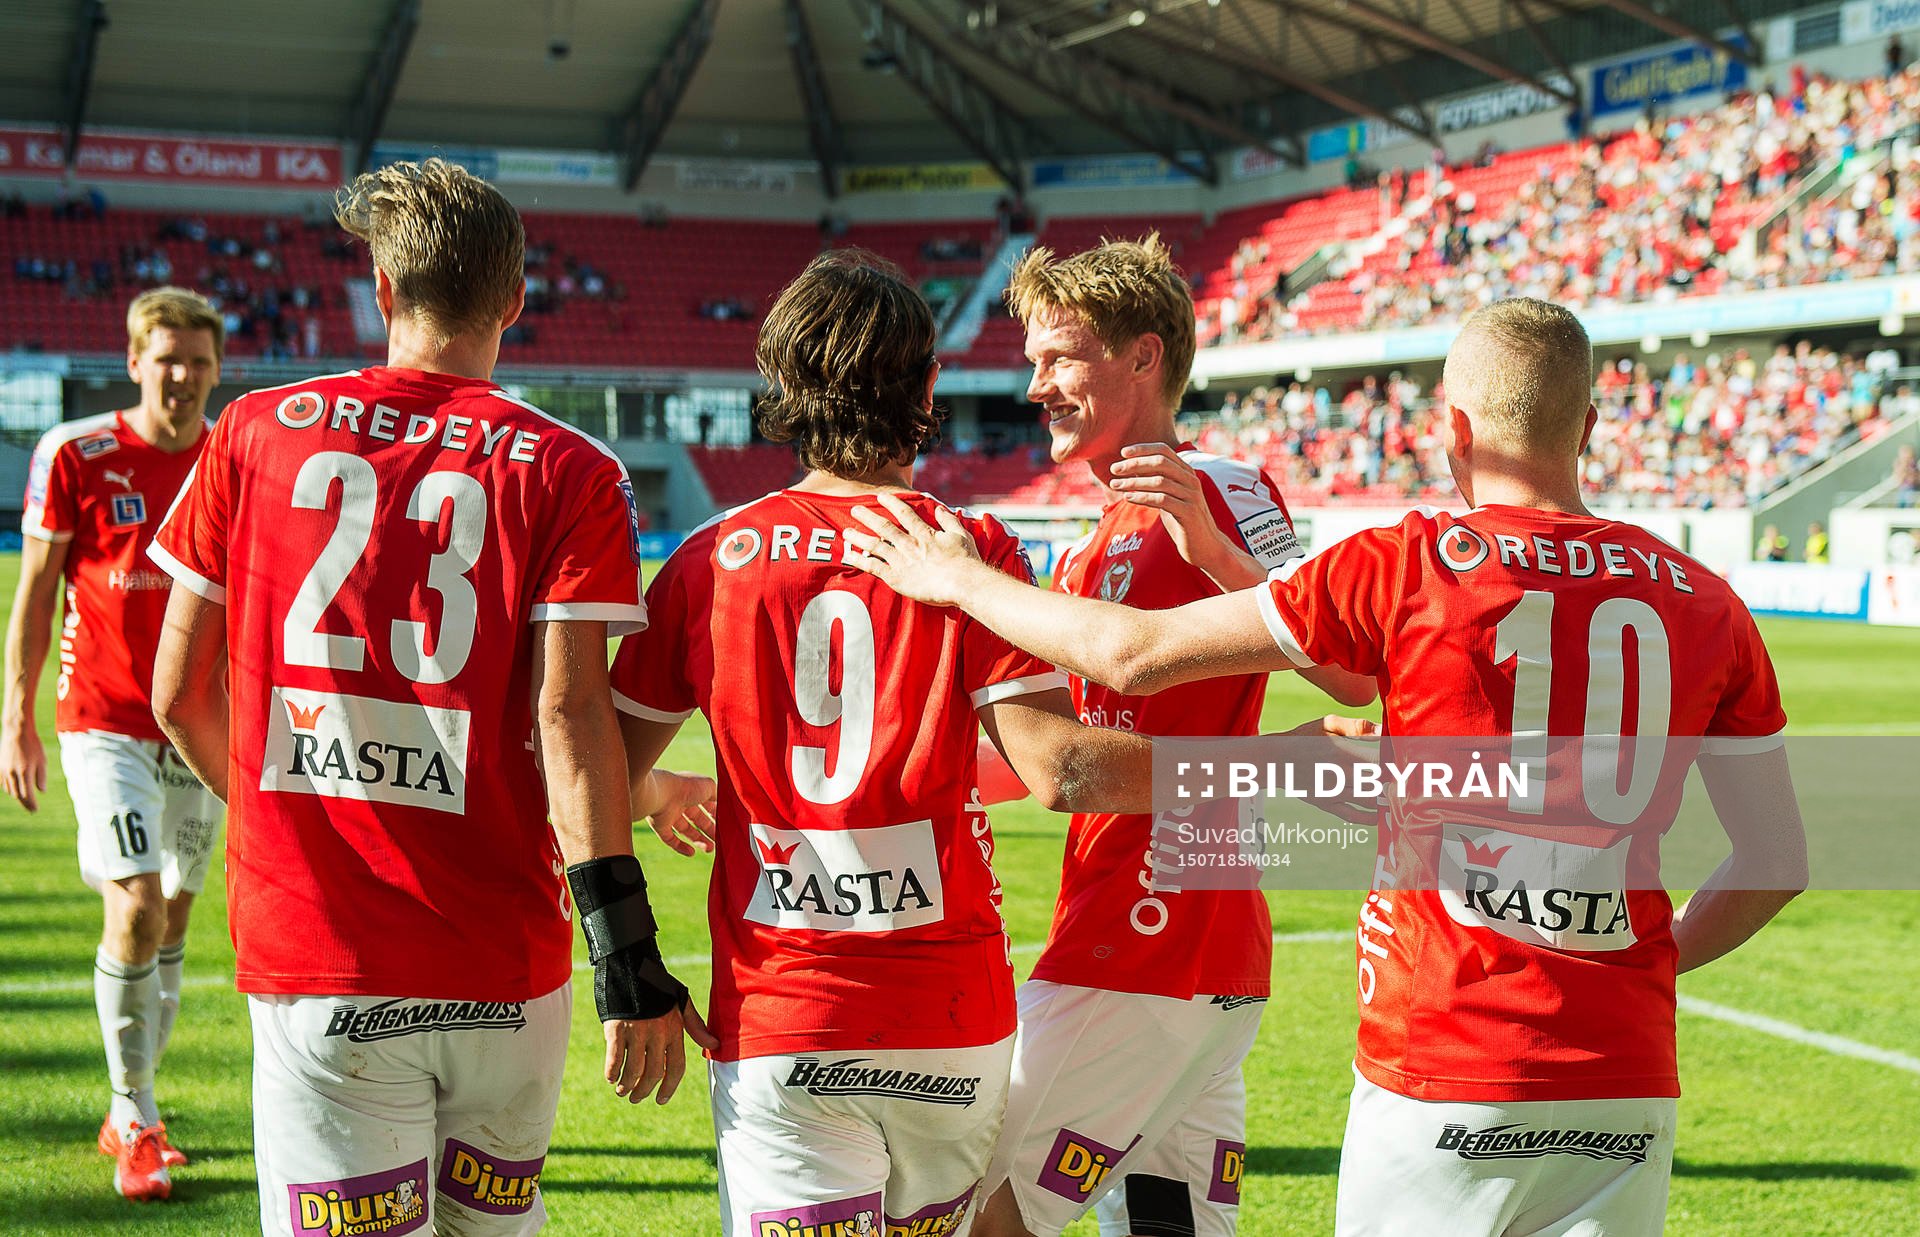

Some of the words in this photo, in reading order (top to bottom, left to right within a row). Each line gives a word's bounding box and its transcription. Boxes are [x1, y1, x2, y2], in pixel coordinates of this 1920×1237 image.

[25, 138, 136, 171] Kamar
[143, 143, 168, 174] &
[175, 140, 261, 178] Öland
[276, 148, 328, 180] ICA
[1244, 517, 1286, 539] KalmarPost
[1254, 533, 1293, 555] EMMABO
[284, 451, 487, 684] 23
[791, 590, 875, 805] 9
[1494, 590, 1671, 824] 10
[287, 733, 456, 796] RASTA
[110, 809, 150, 857] 16
[764, 867, 934, 917] RASTA
[1463, 868, 1630, 935] RASTA
[324, 1000, 527, 1037] BERGKVARABUSS
[785, 1057, 981, 1096] BERGKVARABUSS
[1435, 1123, 1655, 1151] BERGKVARABUSS
